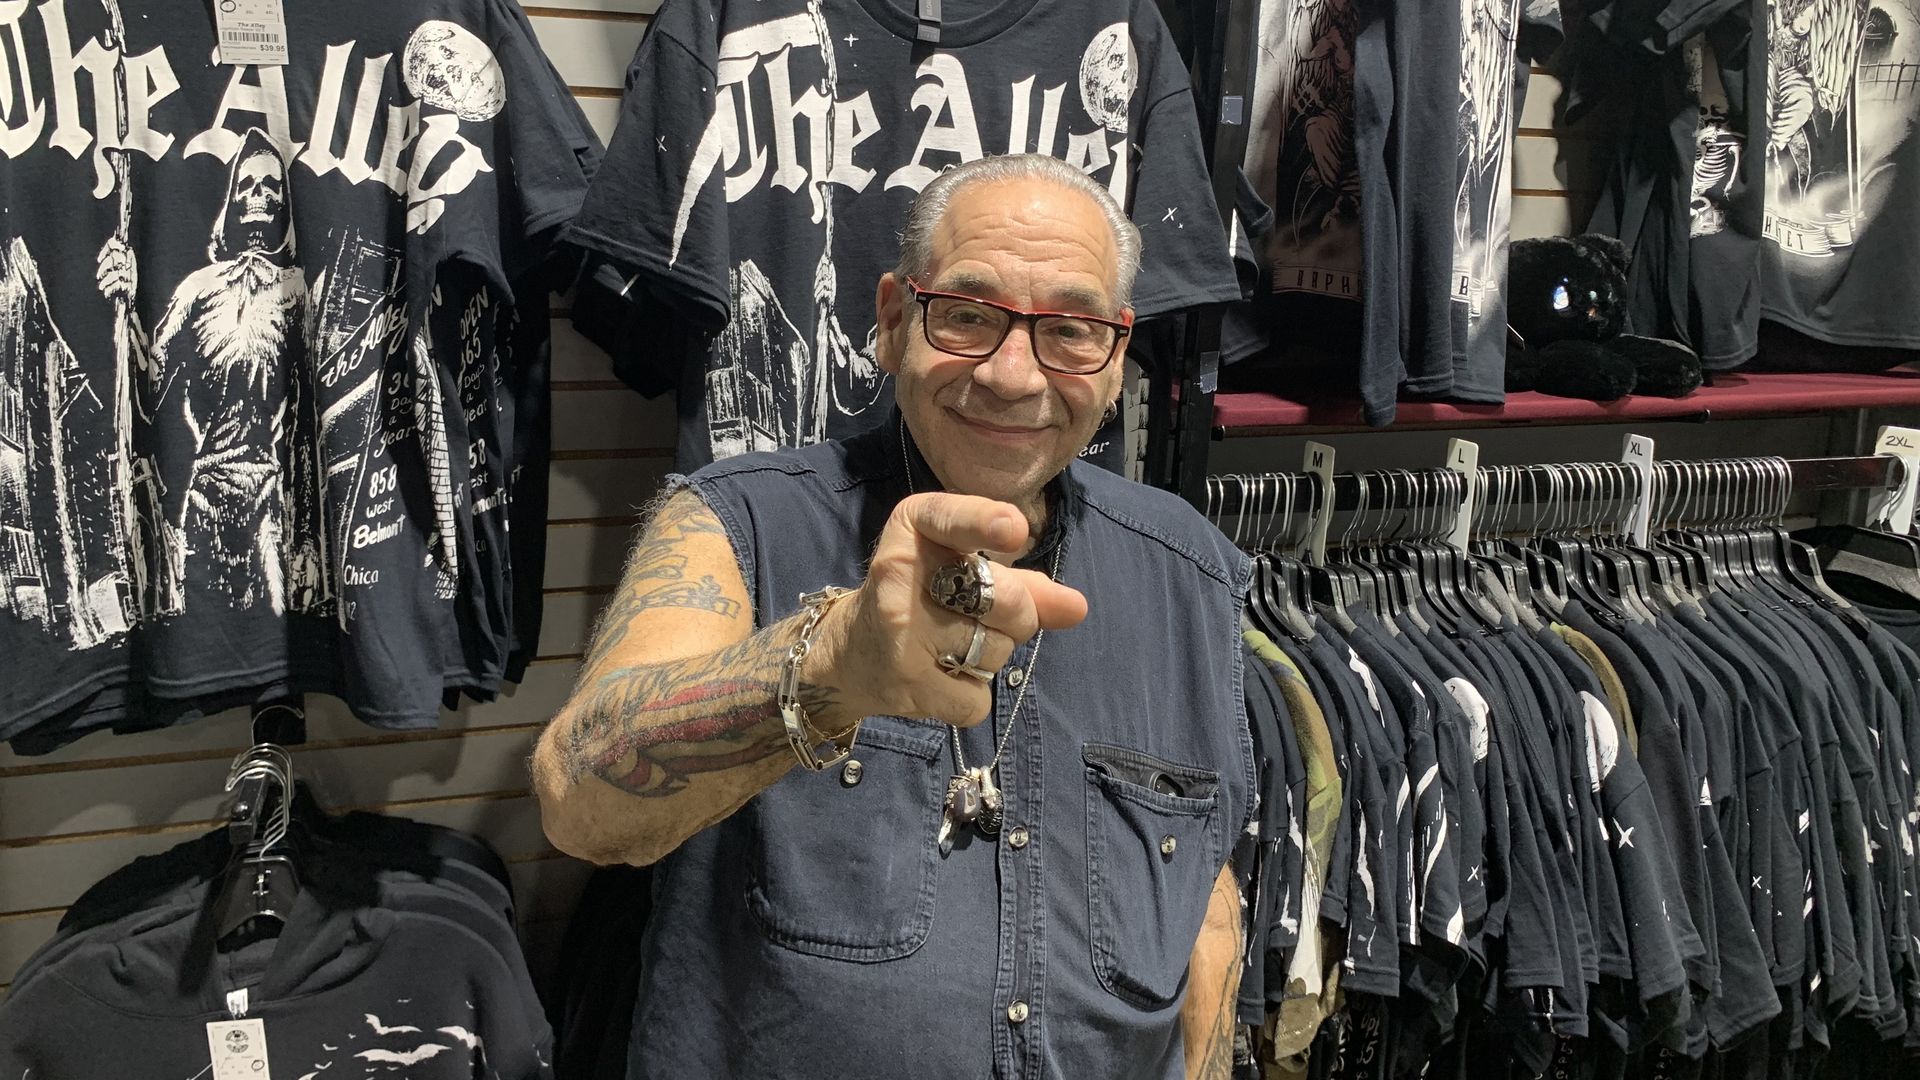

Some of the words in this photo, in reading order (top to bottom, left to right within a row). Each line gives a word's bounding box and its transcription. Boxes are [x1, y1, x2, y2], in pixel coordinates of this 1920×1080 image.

[260, 44, 286, 52] $39.95
[388, 416, 397, 426] a
[1078, 441, 1110, 458] ear
[1630, 441, 1643, 456] XL
[1885, 435, 1914, 449] 2XL
[469, 438, 486, 469] 58
[1312, 450, 1324, 468] M
[1457, 447, 1465, 464] L
[368, 463, 398, 498] 858
[471, 470, 488, 488] est
[353, 513, 406, 549] Belmont
